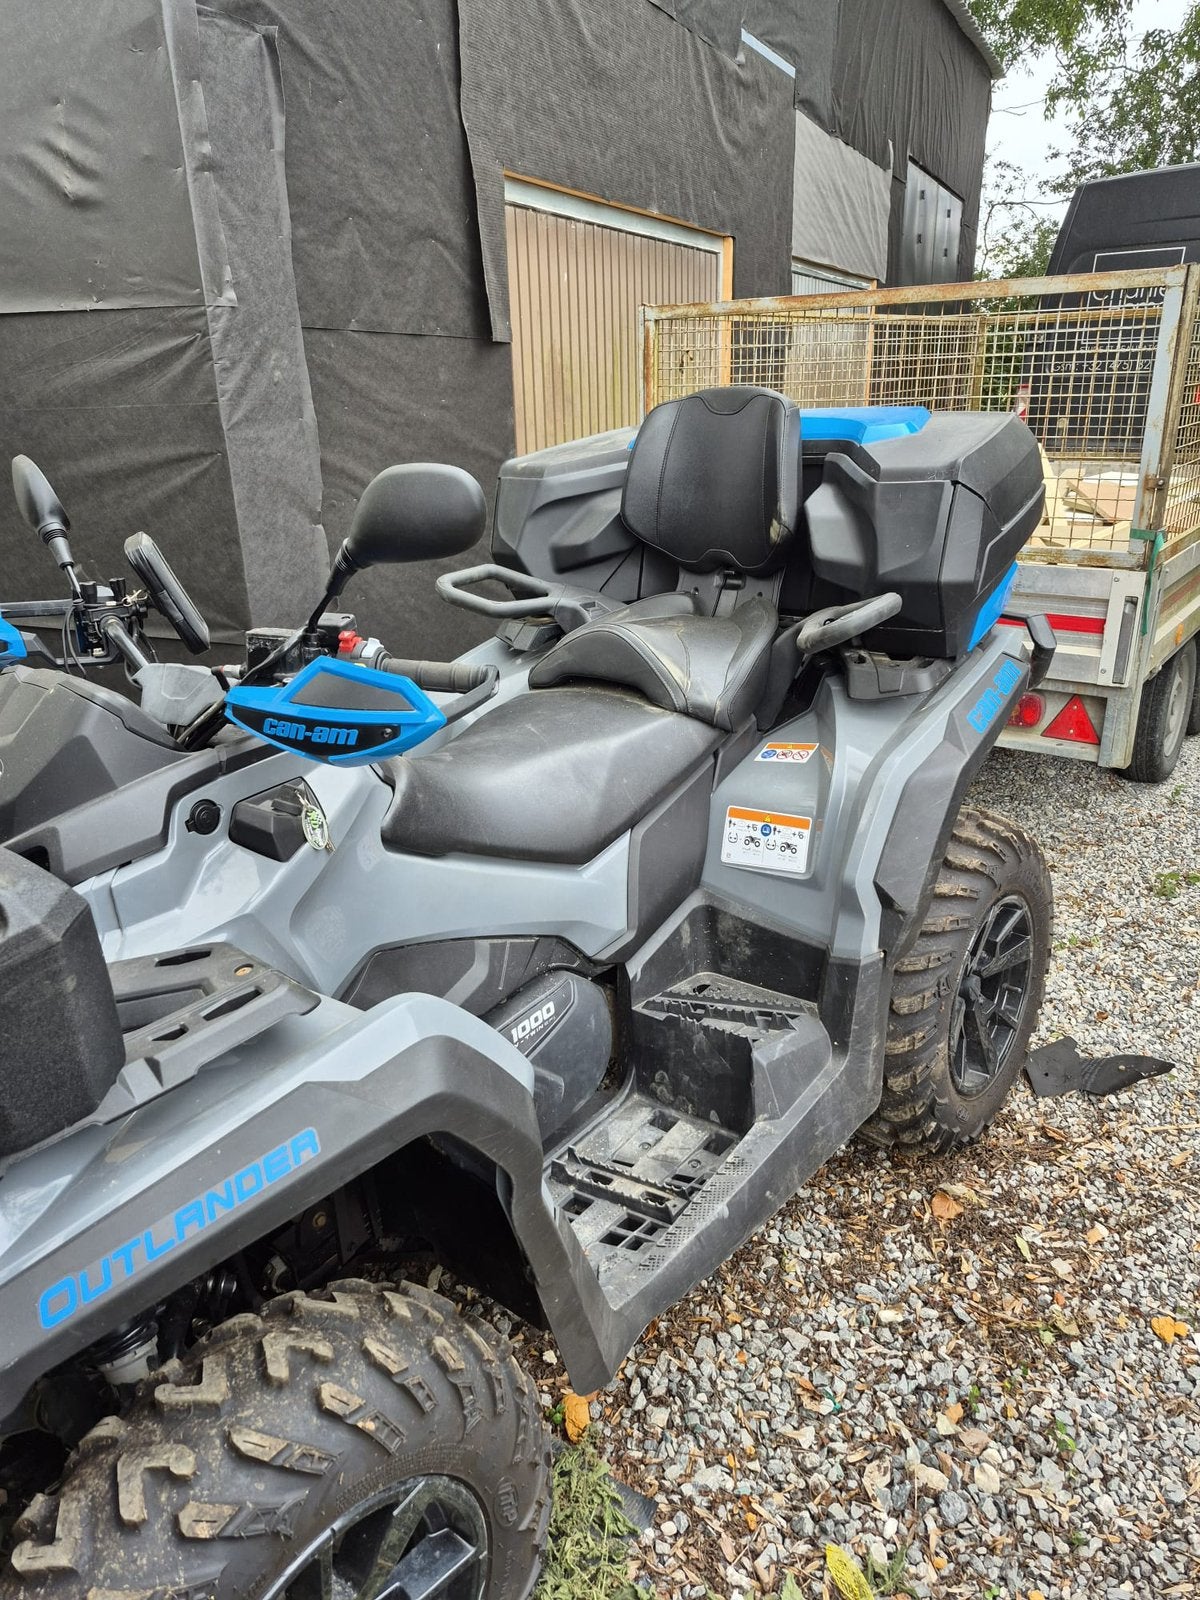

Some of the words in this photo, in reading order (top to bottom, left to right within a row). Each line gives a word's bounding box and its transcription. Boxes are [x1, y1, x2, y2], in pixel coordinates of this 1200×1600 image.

[966, 659, 1021, 733] can-am
[263, 718, 358, 745] can-am
[511, 1001, 555, 1043] 1000
[39, 1126, 321, 1329] OUTLANDER
